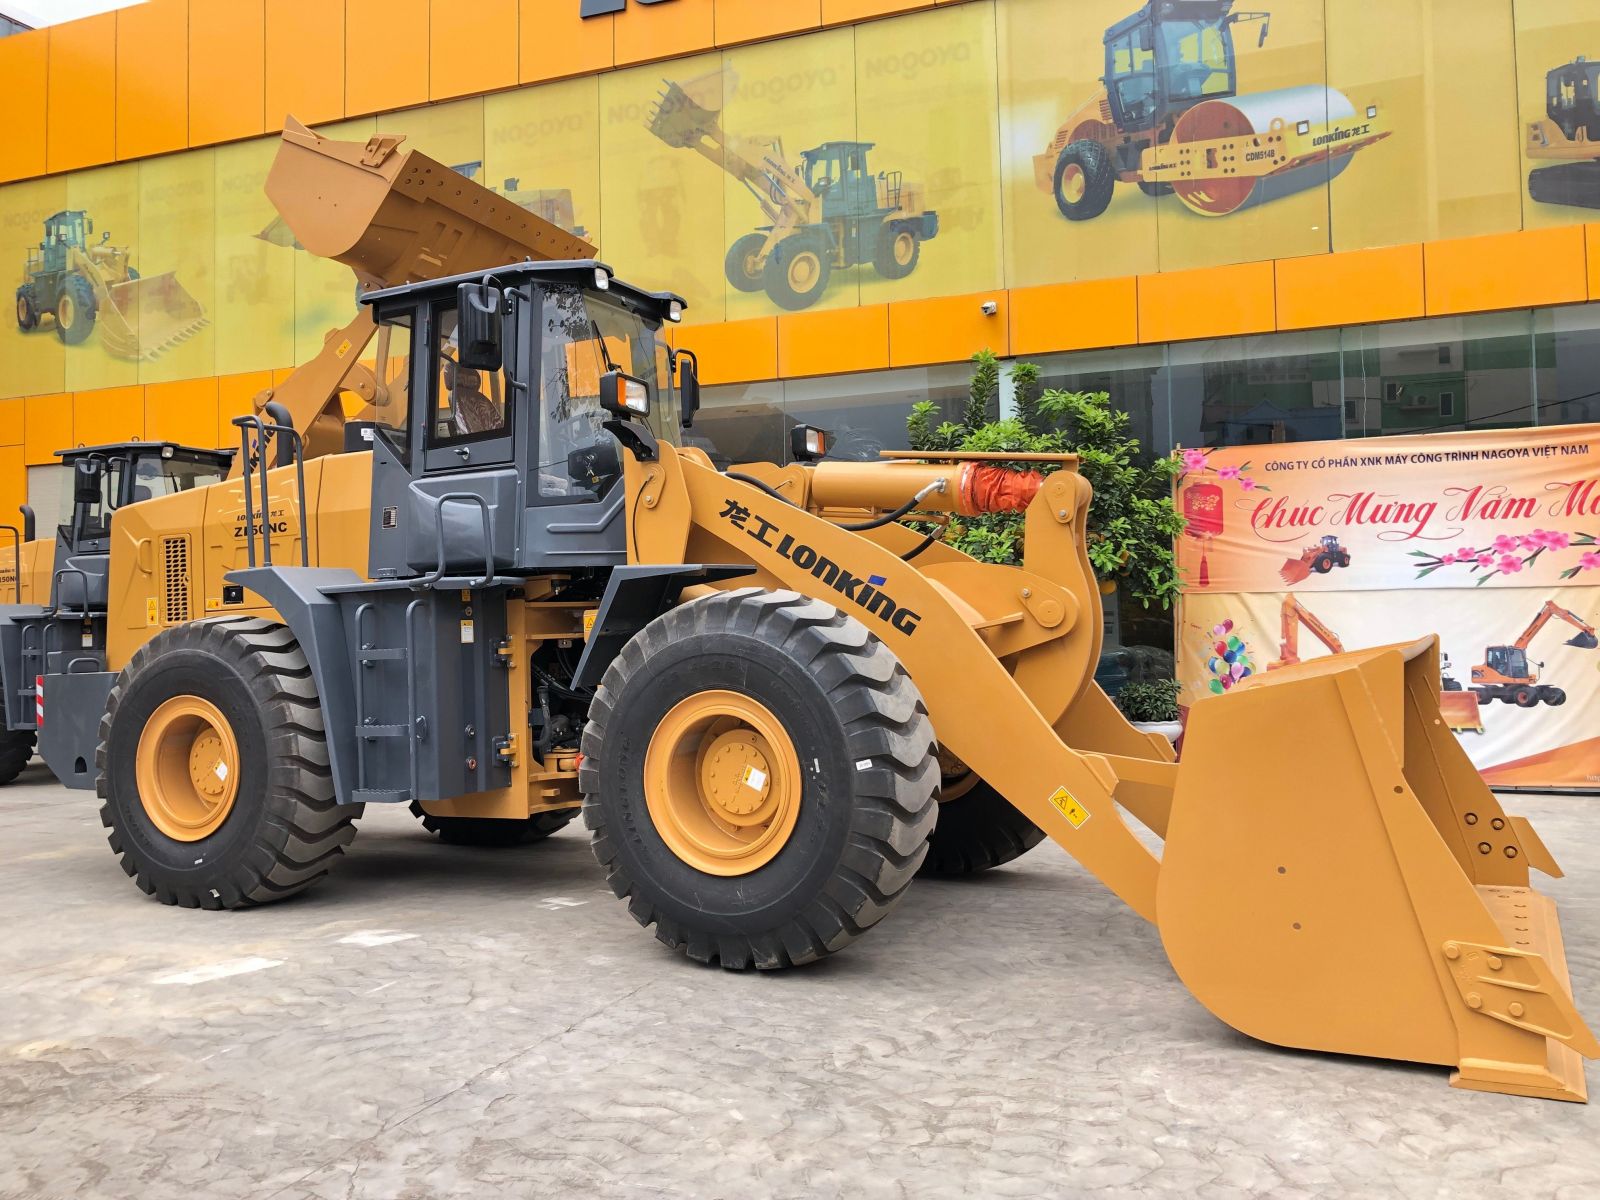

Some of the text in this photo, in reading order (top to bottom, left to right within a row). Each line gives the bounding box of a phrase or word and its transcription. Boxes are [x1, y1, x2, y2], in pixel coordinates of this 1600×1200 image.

[1245, 149, 1275, 162] CDM514B
[1265, 460, 1294, 472] CÔNG
[1296, 461, 1309, 470] TY
[1360, 456, 1382, 466] XNK
[1385, 453, 1408, 465] MÁY
[1411, 452, 1442, 464] CÔNG
[1445, 450, 1479, 462] TRÌNH
[1482, 448, 1530, 460] NAGOYA
[1533, 445, 1558, 459] VIỆT
[1561, 444, 1589, 455] NAM
[719, 498, 779, 548] 龙工
